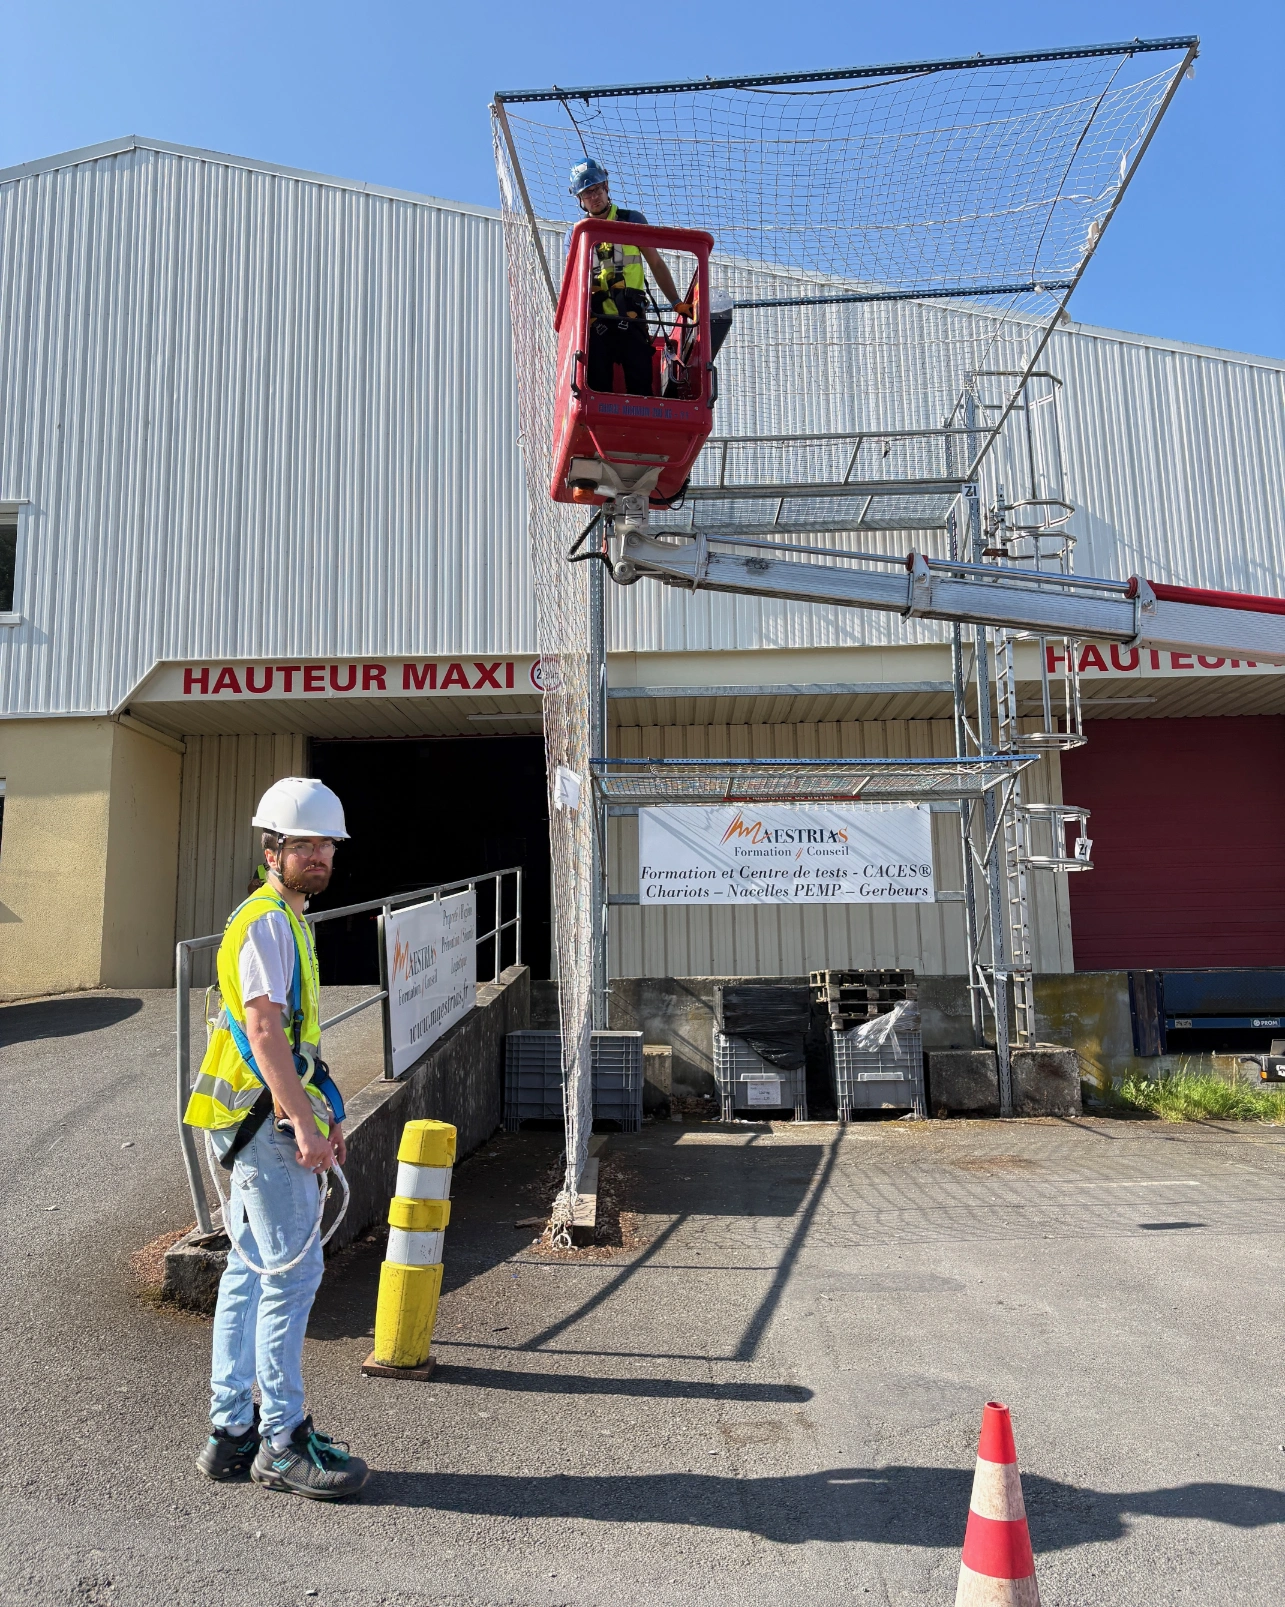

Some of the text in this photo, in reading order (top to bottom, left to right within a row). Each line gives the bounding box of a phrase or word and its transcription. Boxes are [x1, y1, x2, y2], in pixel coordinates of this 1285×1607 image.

[183, 662, 515, 695] HAUTEUR MAXI
[719, 810, 849, 845] MAESTRIAS
[734, 845, 849, 857] Formation Conseil
[641, 866, 717, 879] Formation
[721, 868, 735, 879] et
[740, 865, 789, 879] Centre
[793, 865, 811, 879] de
[815, 865, 848, 879] tests
[863, 864, 932, 878] CACES®
[646, 884, 710, 898] Chariots
[727, 883, 789, 898] Nacelles
[793, 883, 842, 897] PEMP
[859, 883, 928, 897] Gerbeurs
[392, 927, 437, 986] MAESTRIAS
[398, 968, 438, 1007] Formation Conseil
[409, 978, 469, 1045] www.maestrias.fr
